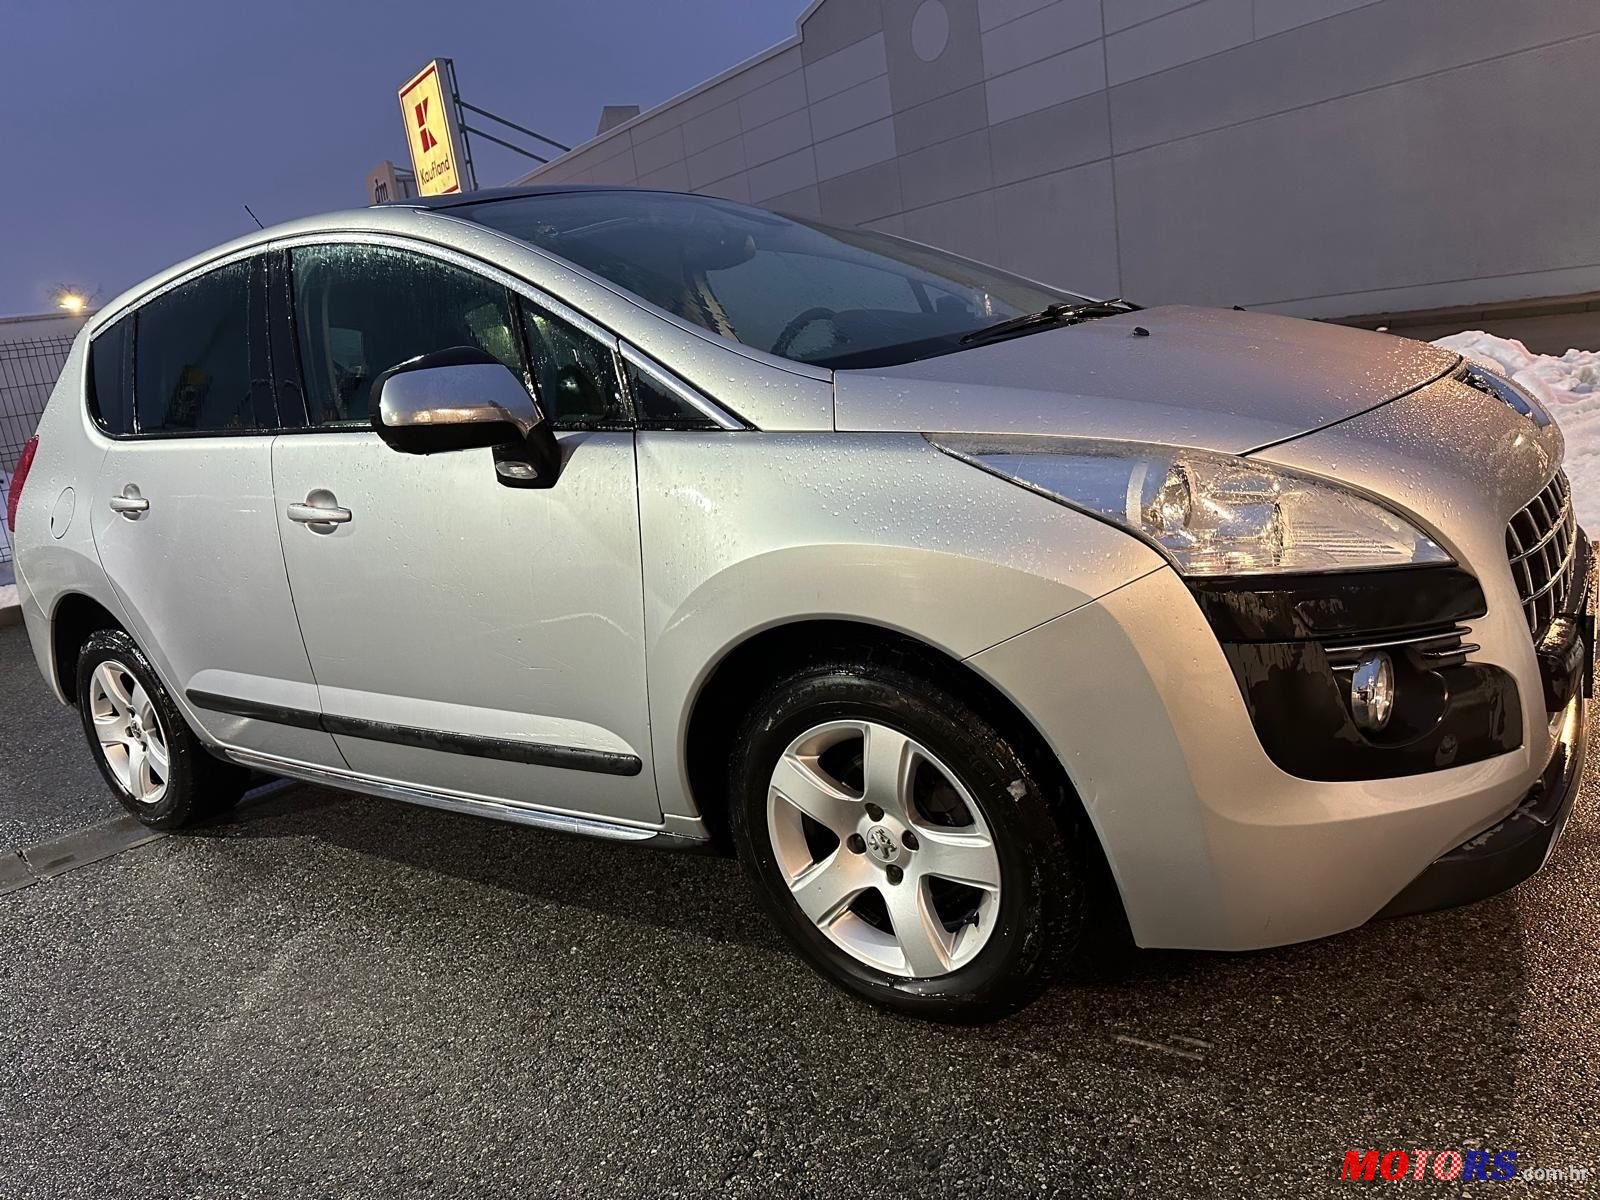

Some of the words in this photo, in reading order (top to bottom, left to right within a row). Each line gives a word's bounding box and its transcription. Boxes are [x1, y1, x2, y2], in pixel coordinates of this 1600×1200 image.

[414, 97, 438, 153] K
[420, 153, 450, 185] Kaufland
[375, 179, 389, 204] dm
